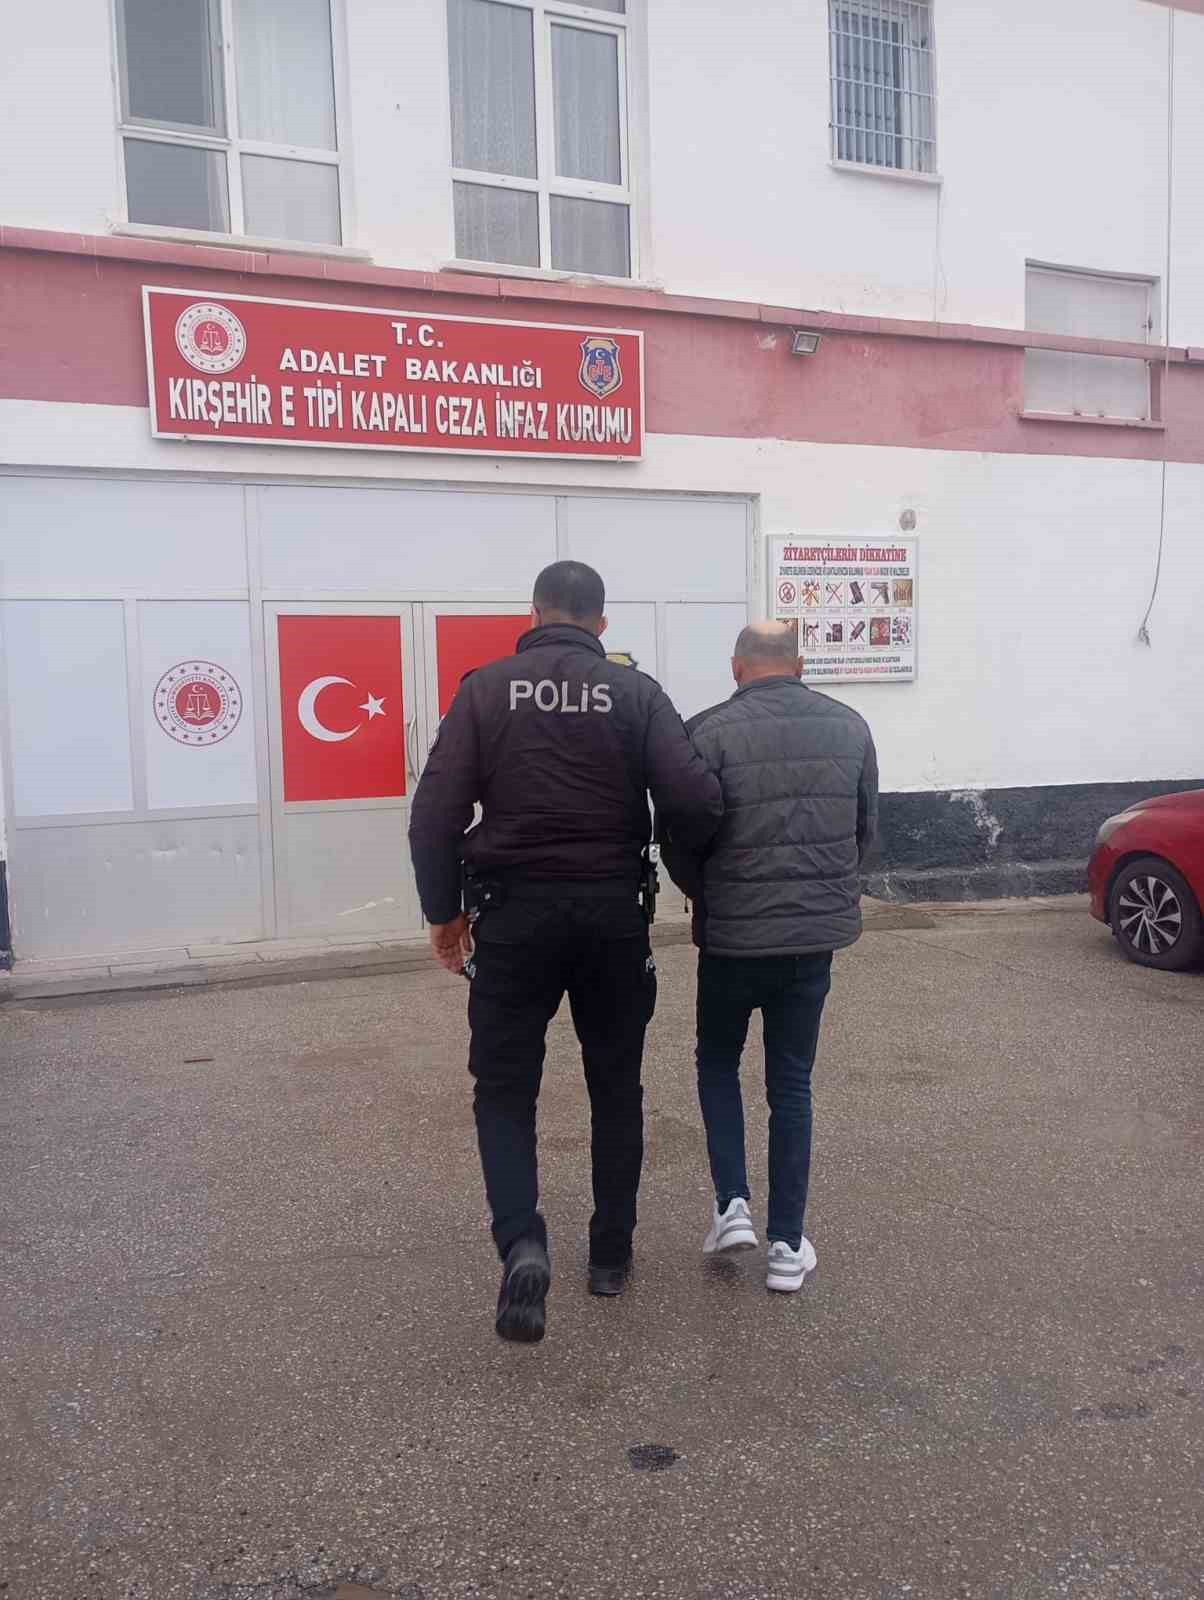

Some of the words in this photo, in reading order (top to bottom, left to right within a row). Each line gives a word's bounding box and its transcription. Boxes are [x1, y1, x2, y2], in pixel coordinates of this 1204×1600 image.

[280, 348, 387, 379] ADALET
[405, 358, 542, 389] BAKANLIĞI
[168, 374, 273, 430] KIRŞEHİR
[280, 385, 296, 427] E
[303, 380, 344, 429] TİPİ
[351, 390, 428, 433] KAPALI
[435, 394, 488, 437] CEZA
[495, 392, 550, 440] İNFAZ
[555, 403, 632, 444] KURUMU
[783, 543, 857, 565] ZİYARETÇİLERİN
[859, 544, 907, 562] DİKKATİNE
